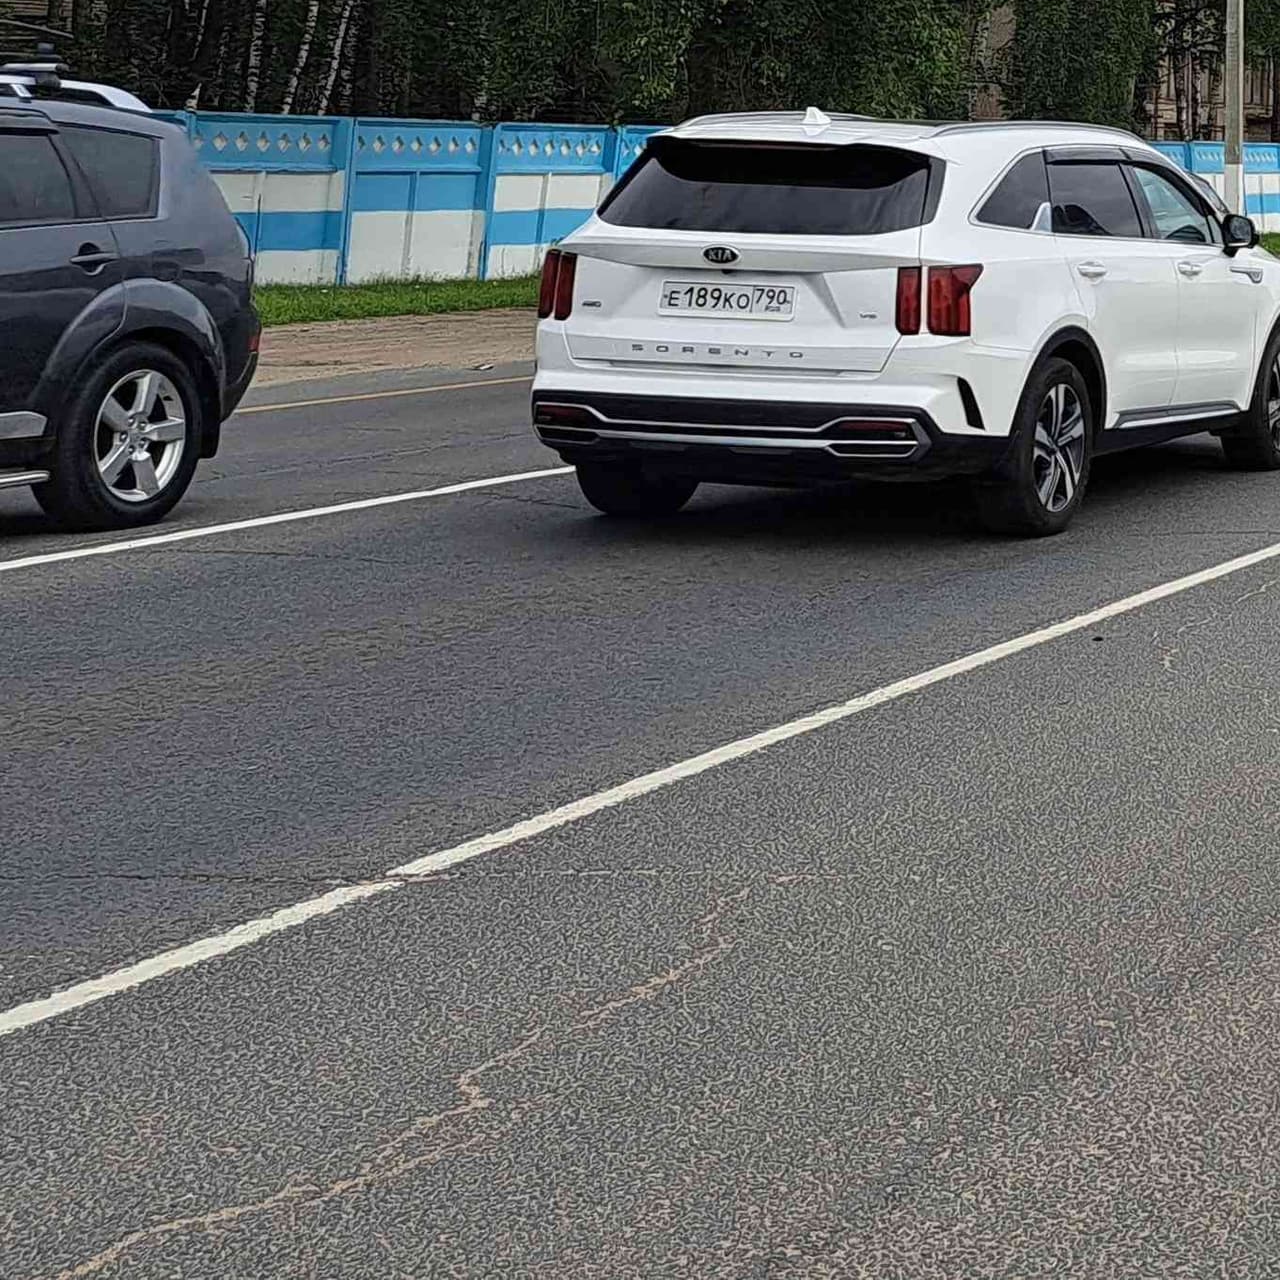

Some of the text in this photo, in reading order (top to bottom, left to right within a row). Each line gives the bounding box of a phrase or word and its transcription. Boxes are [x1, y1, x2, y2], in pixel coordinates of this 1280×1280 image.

[708, 249, 733, 261] KIA
[755, 288, 788, 305] 790
[632, 343, 804, 359] SORENTO
